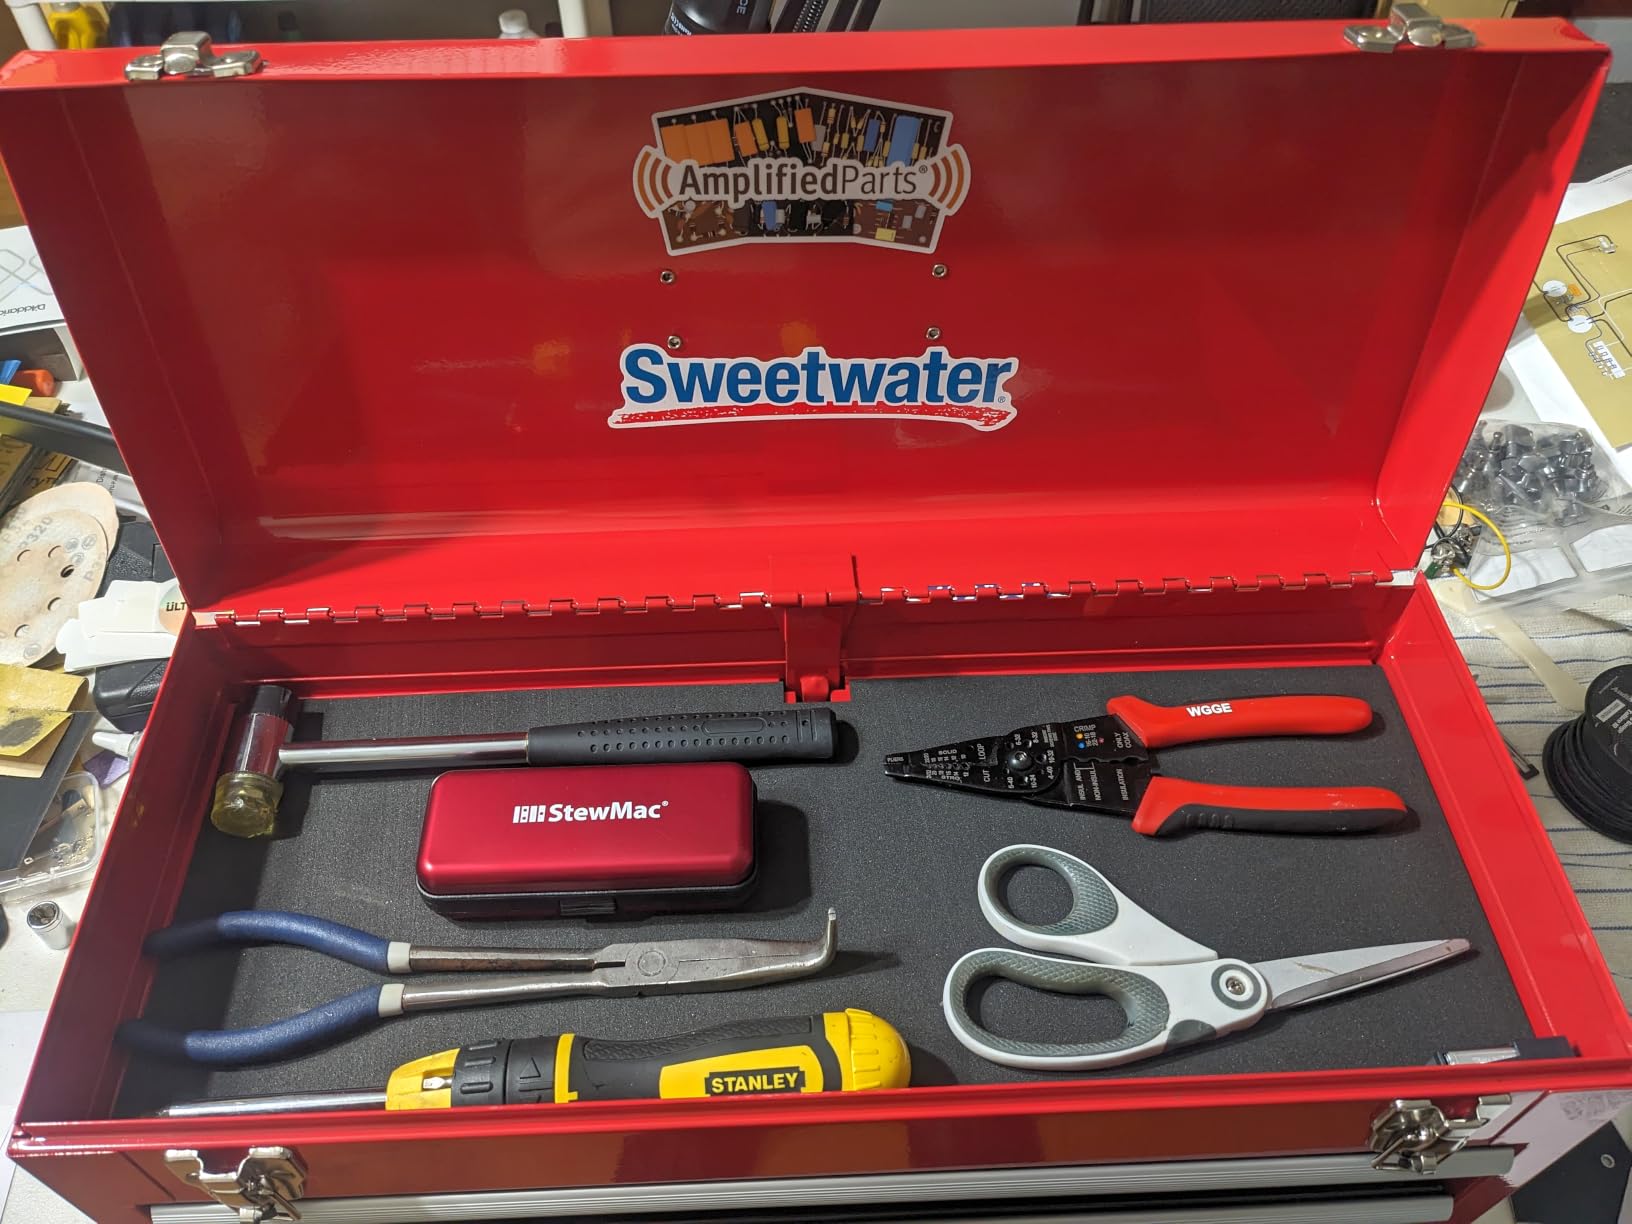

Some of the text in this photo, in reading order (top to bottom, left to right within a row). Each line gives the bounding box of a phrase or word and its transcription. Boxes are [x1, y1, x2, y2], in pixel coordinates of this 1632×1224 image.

[1186, 703, 1232, 717] WGGE
[1114, 732, 1124, 749] ONLY
[1123, 731, 1132, 749] COAX
[976, 743, 986, 760] LOOP
[1077, 784, 1086, 801] INSUL
[1116, 768, 1129, 801] INSULATION
[711, 1072, 799, 1094] STANLEY
